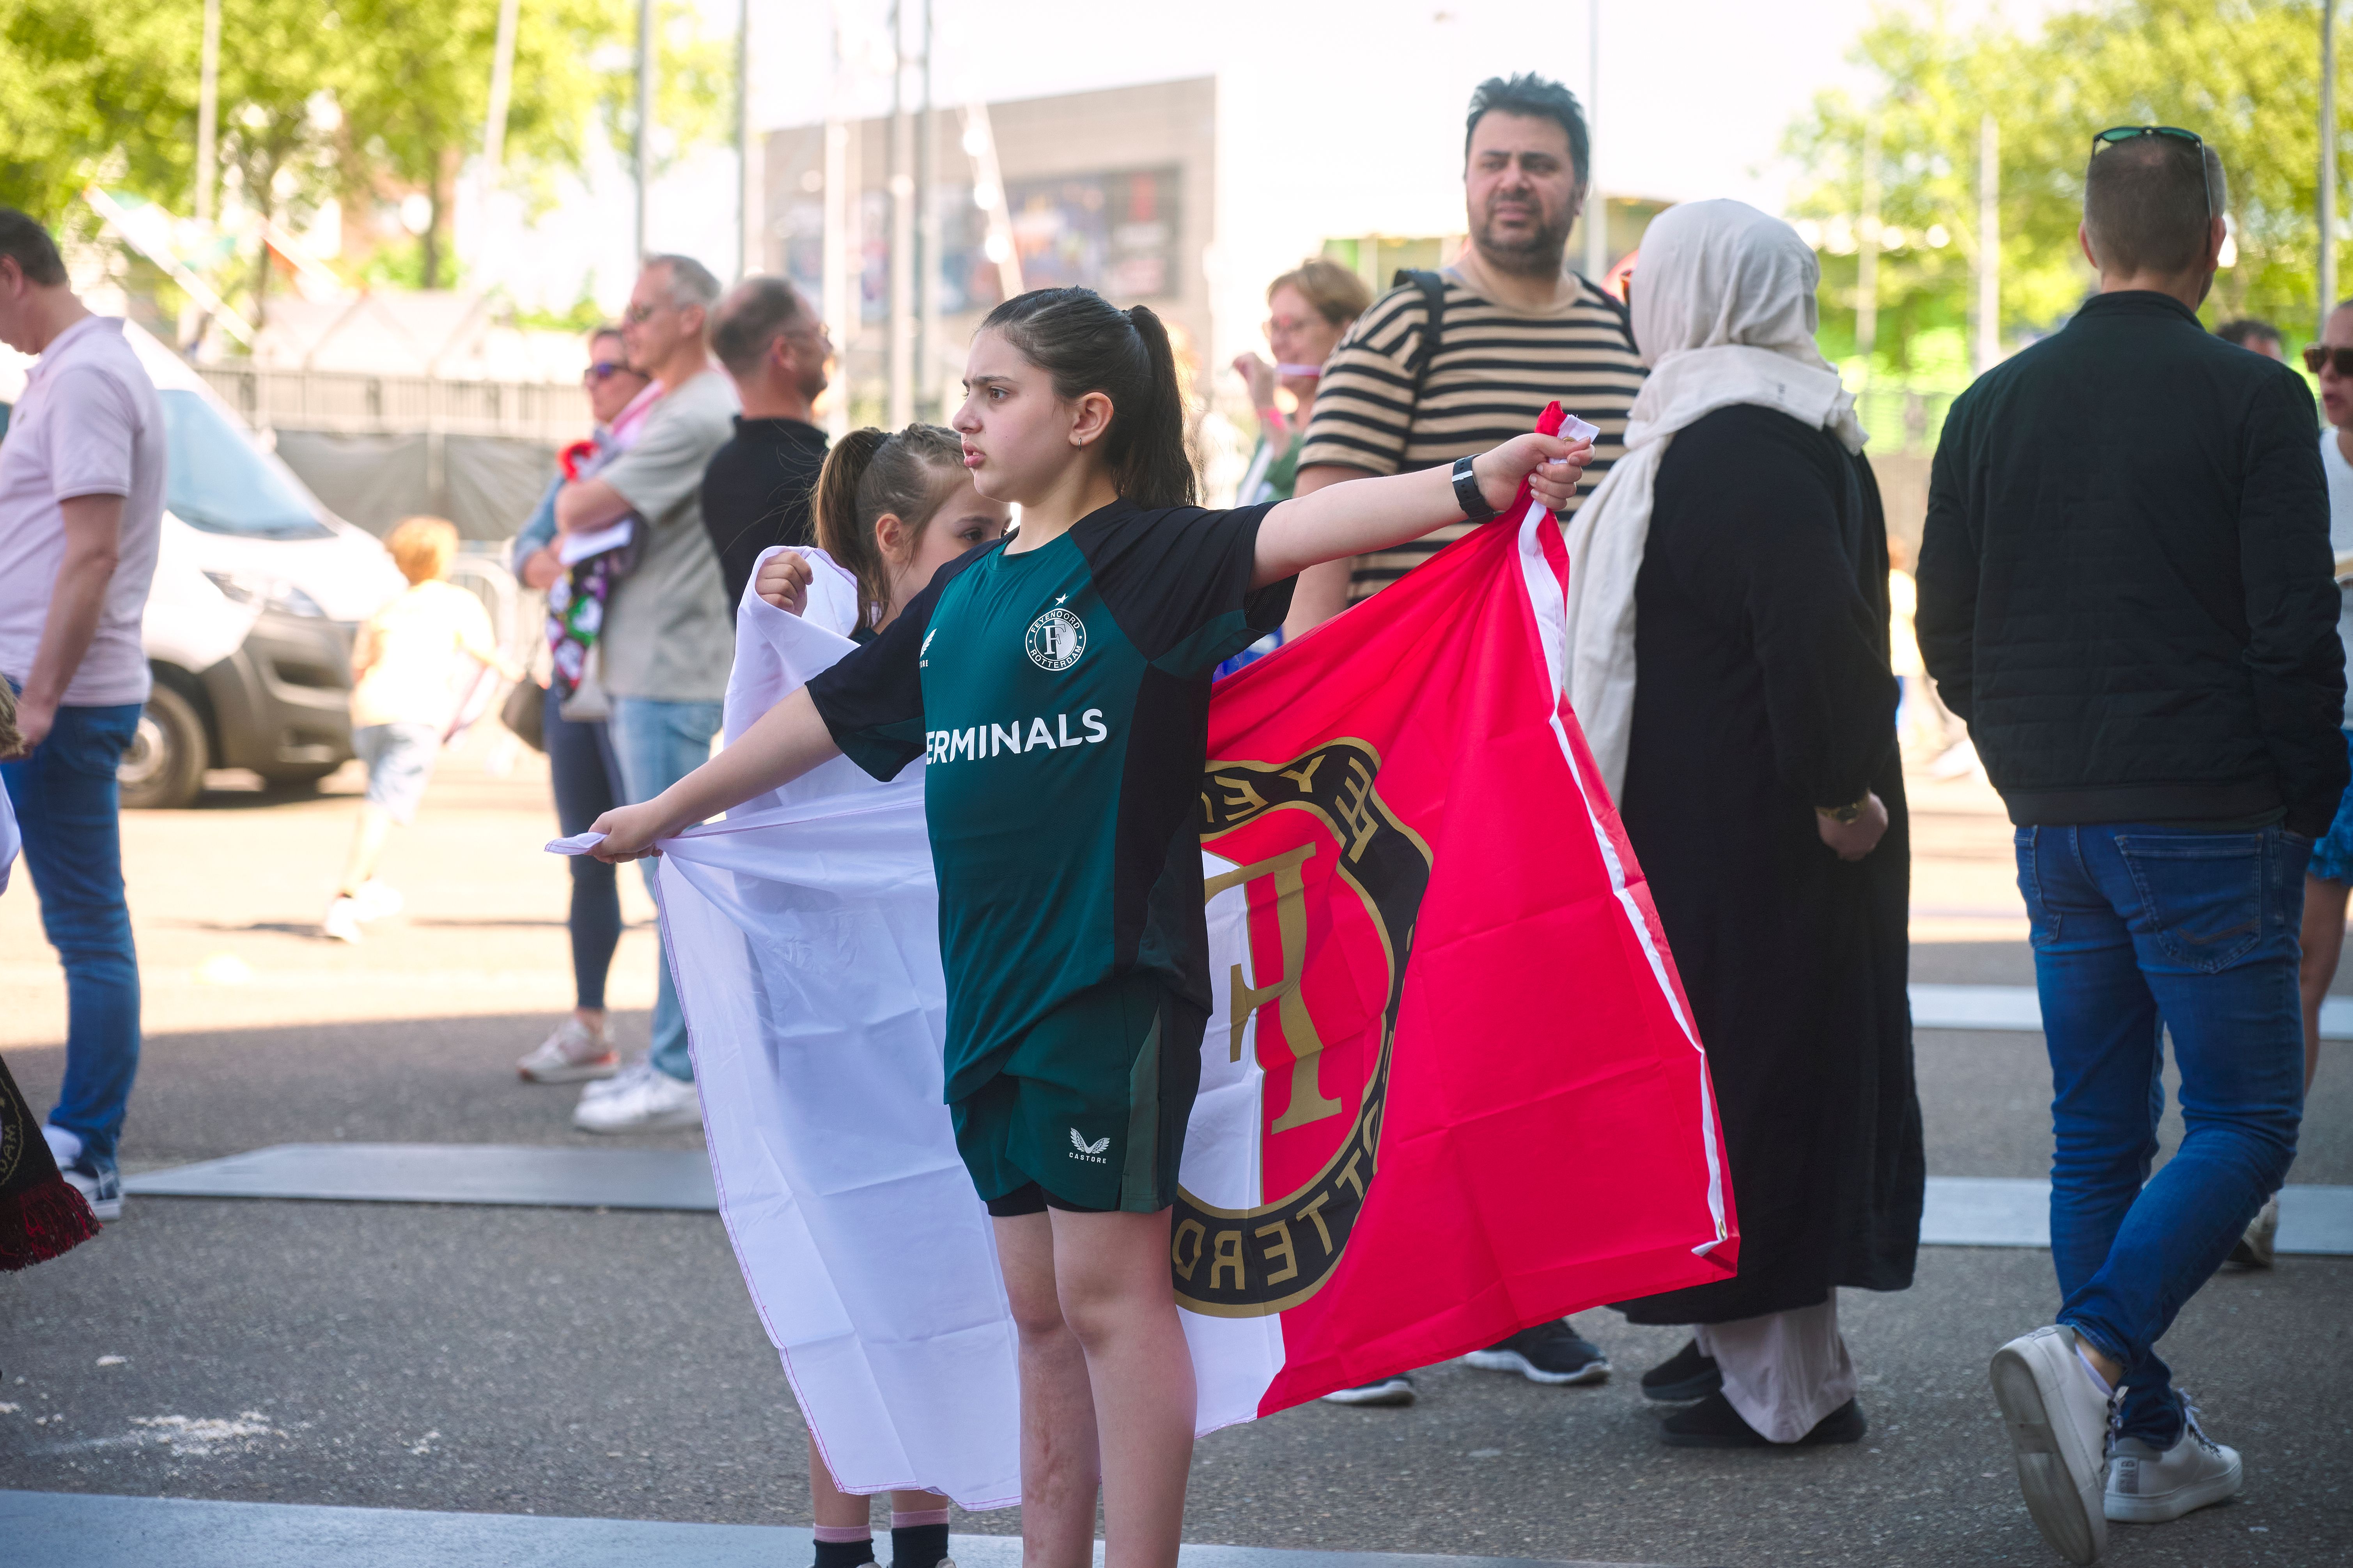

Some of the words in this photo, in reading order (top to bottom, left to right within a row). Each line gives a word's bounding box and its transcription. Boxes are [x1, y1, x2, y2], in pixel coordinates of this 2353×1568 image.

[1031, 611, 1080, 633] FEYENOORD
[1043, 624, 1066, 655] F
[920, 660, 928, 669] ORE
[1030, 645, 1082, 668] ROTTERDAM
[926, 708, 1107, 765] ERMINALS
[1069, 1152, 1107, 1164] CASTORE
